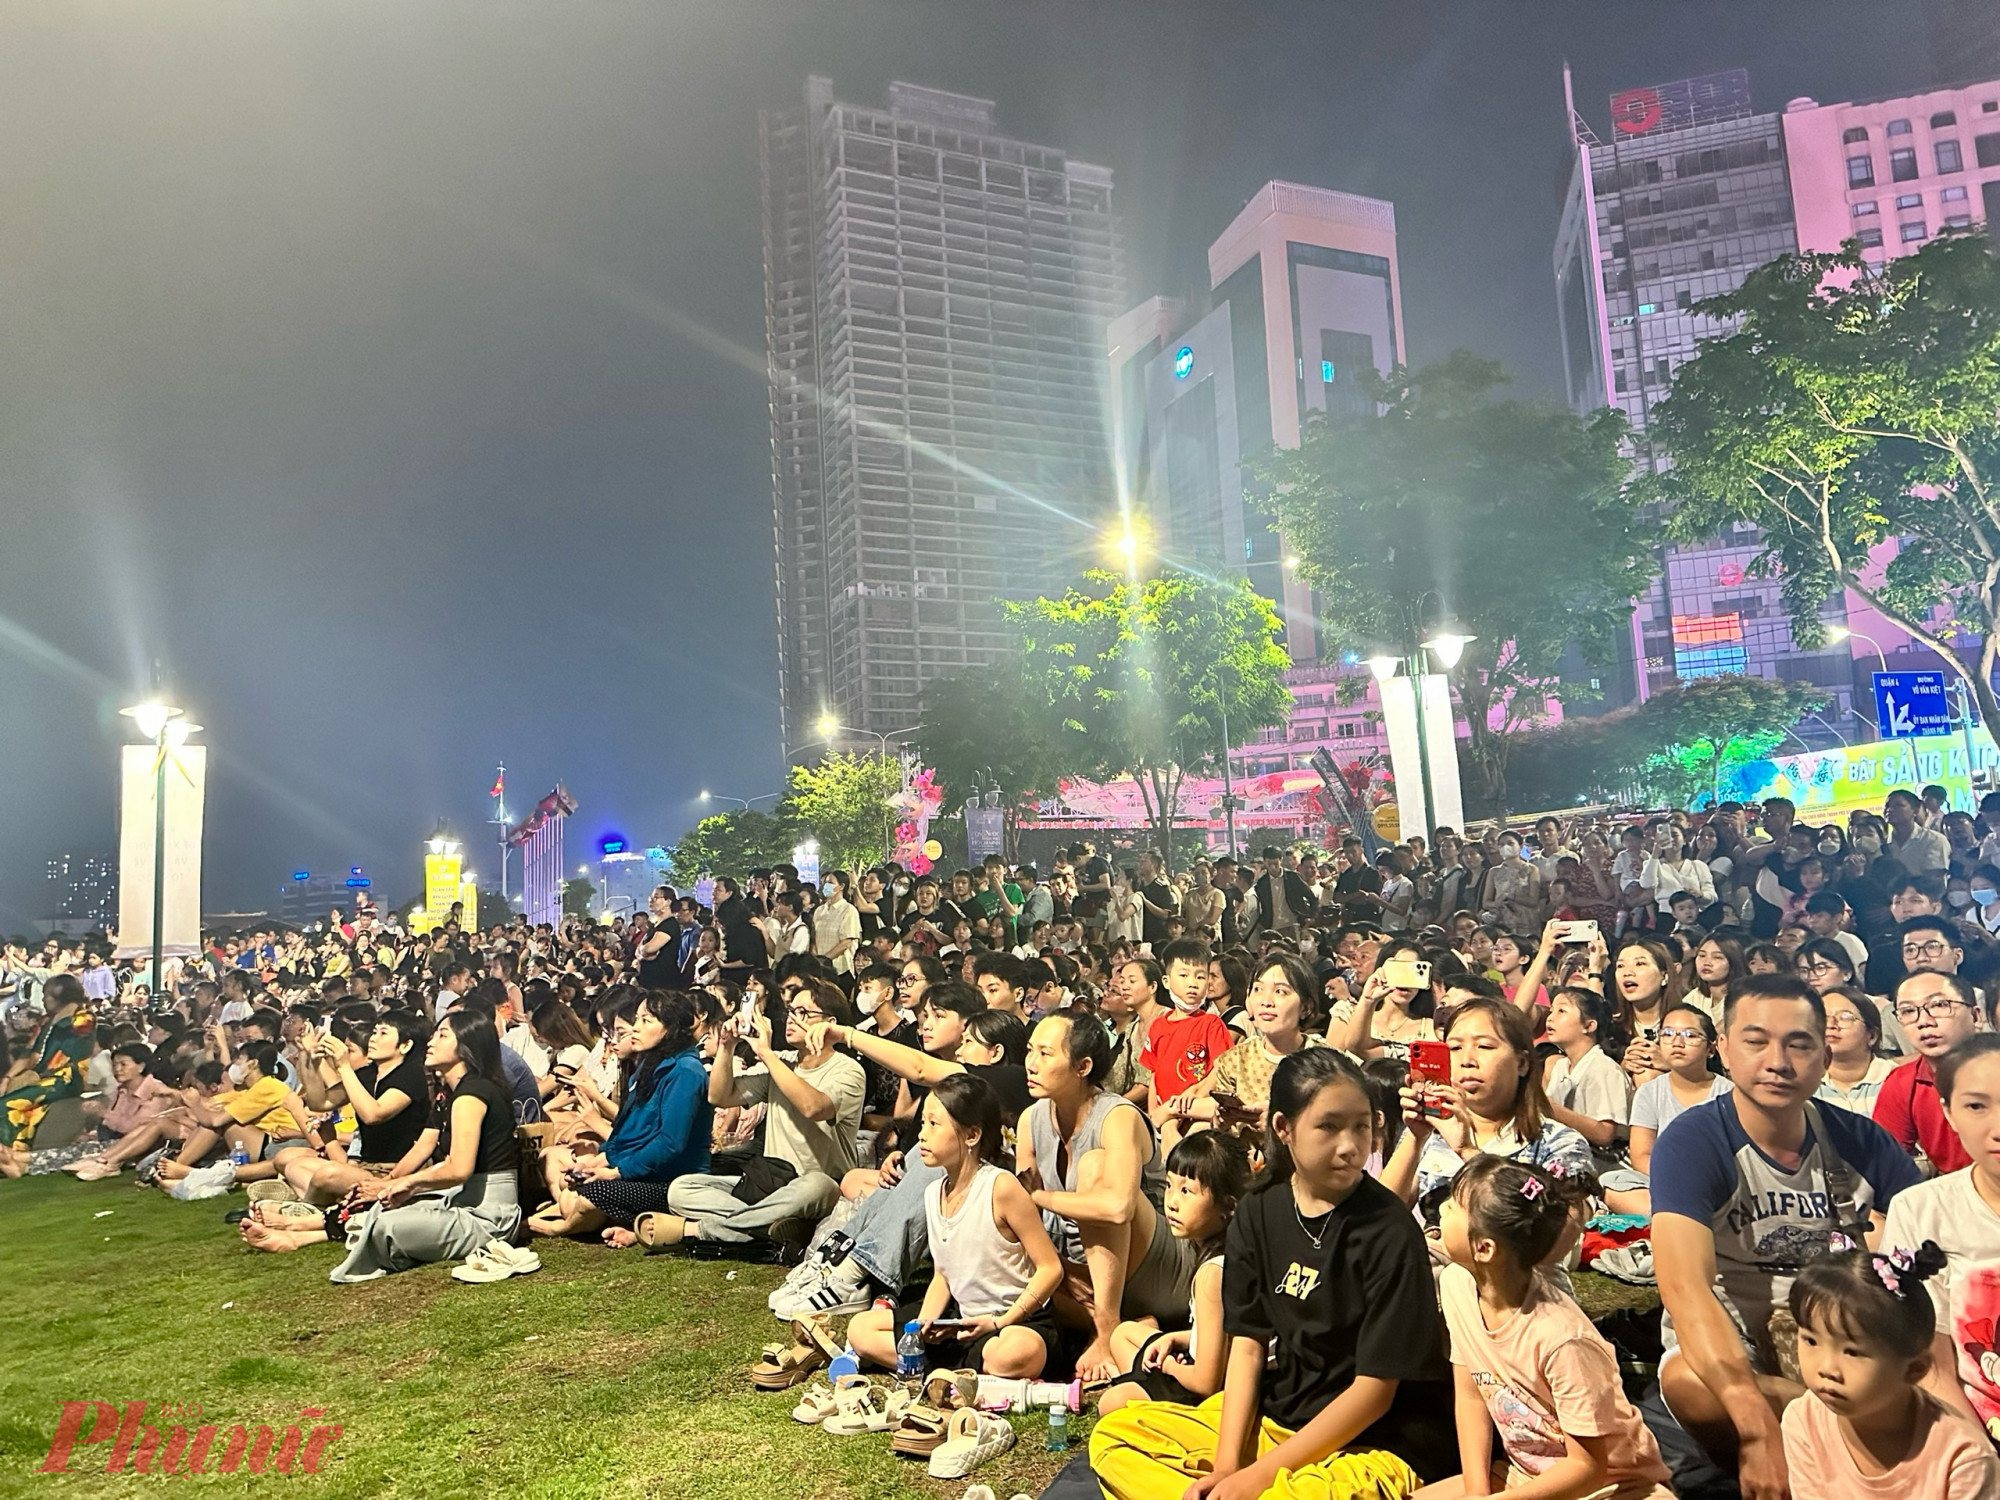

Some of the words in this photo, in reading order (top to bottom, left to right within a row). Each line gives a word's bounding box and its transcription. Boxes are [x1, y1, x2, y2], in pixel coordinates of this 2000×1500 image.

[1880, 677, 1895, 687] QUẬN
[1920, 685, 1930, 694] VĂN
[1930, 685, 1941, 695] KIỆT
[1849, 755, 1877, 785] BẬT
[1882, 744, 1943, 786] SẢNG
[519, 1135, 543, 1149] UST
[1726, 1191, 1836, 1235] CALIFOR
